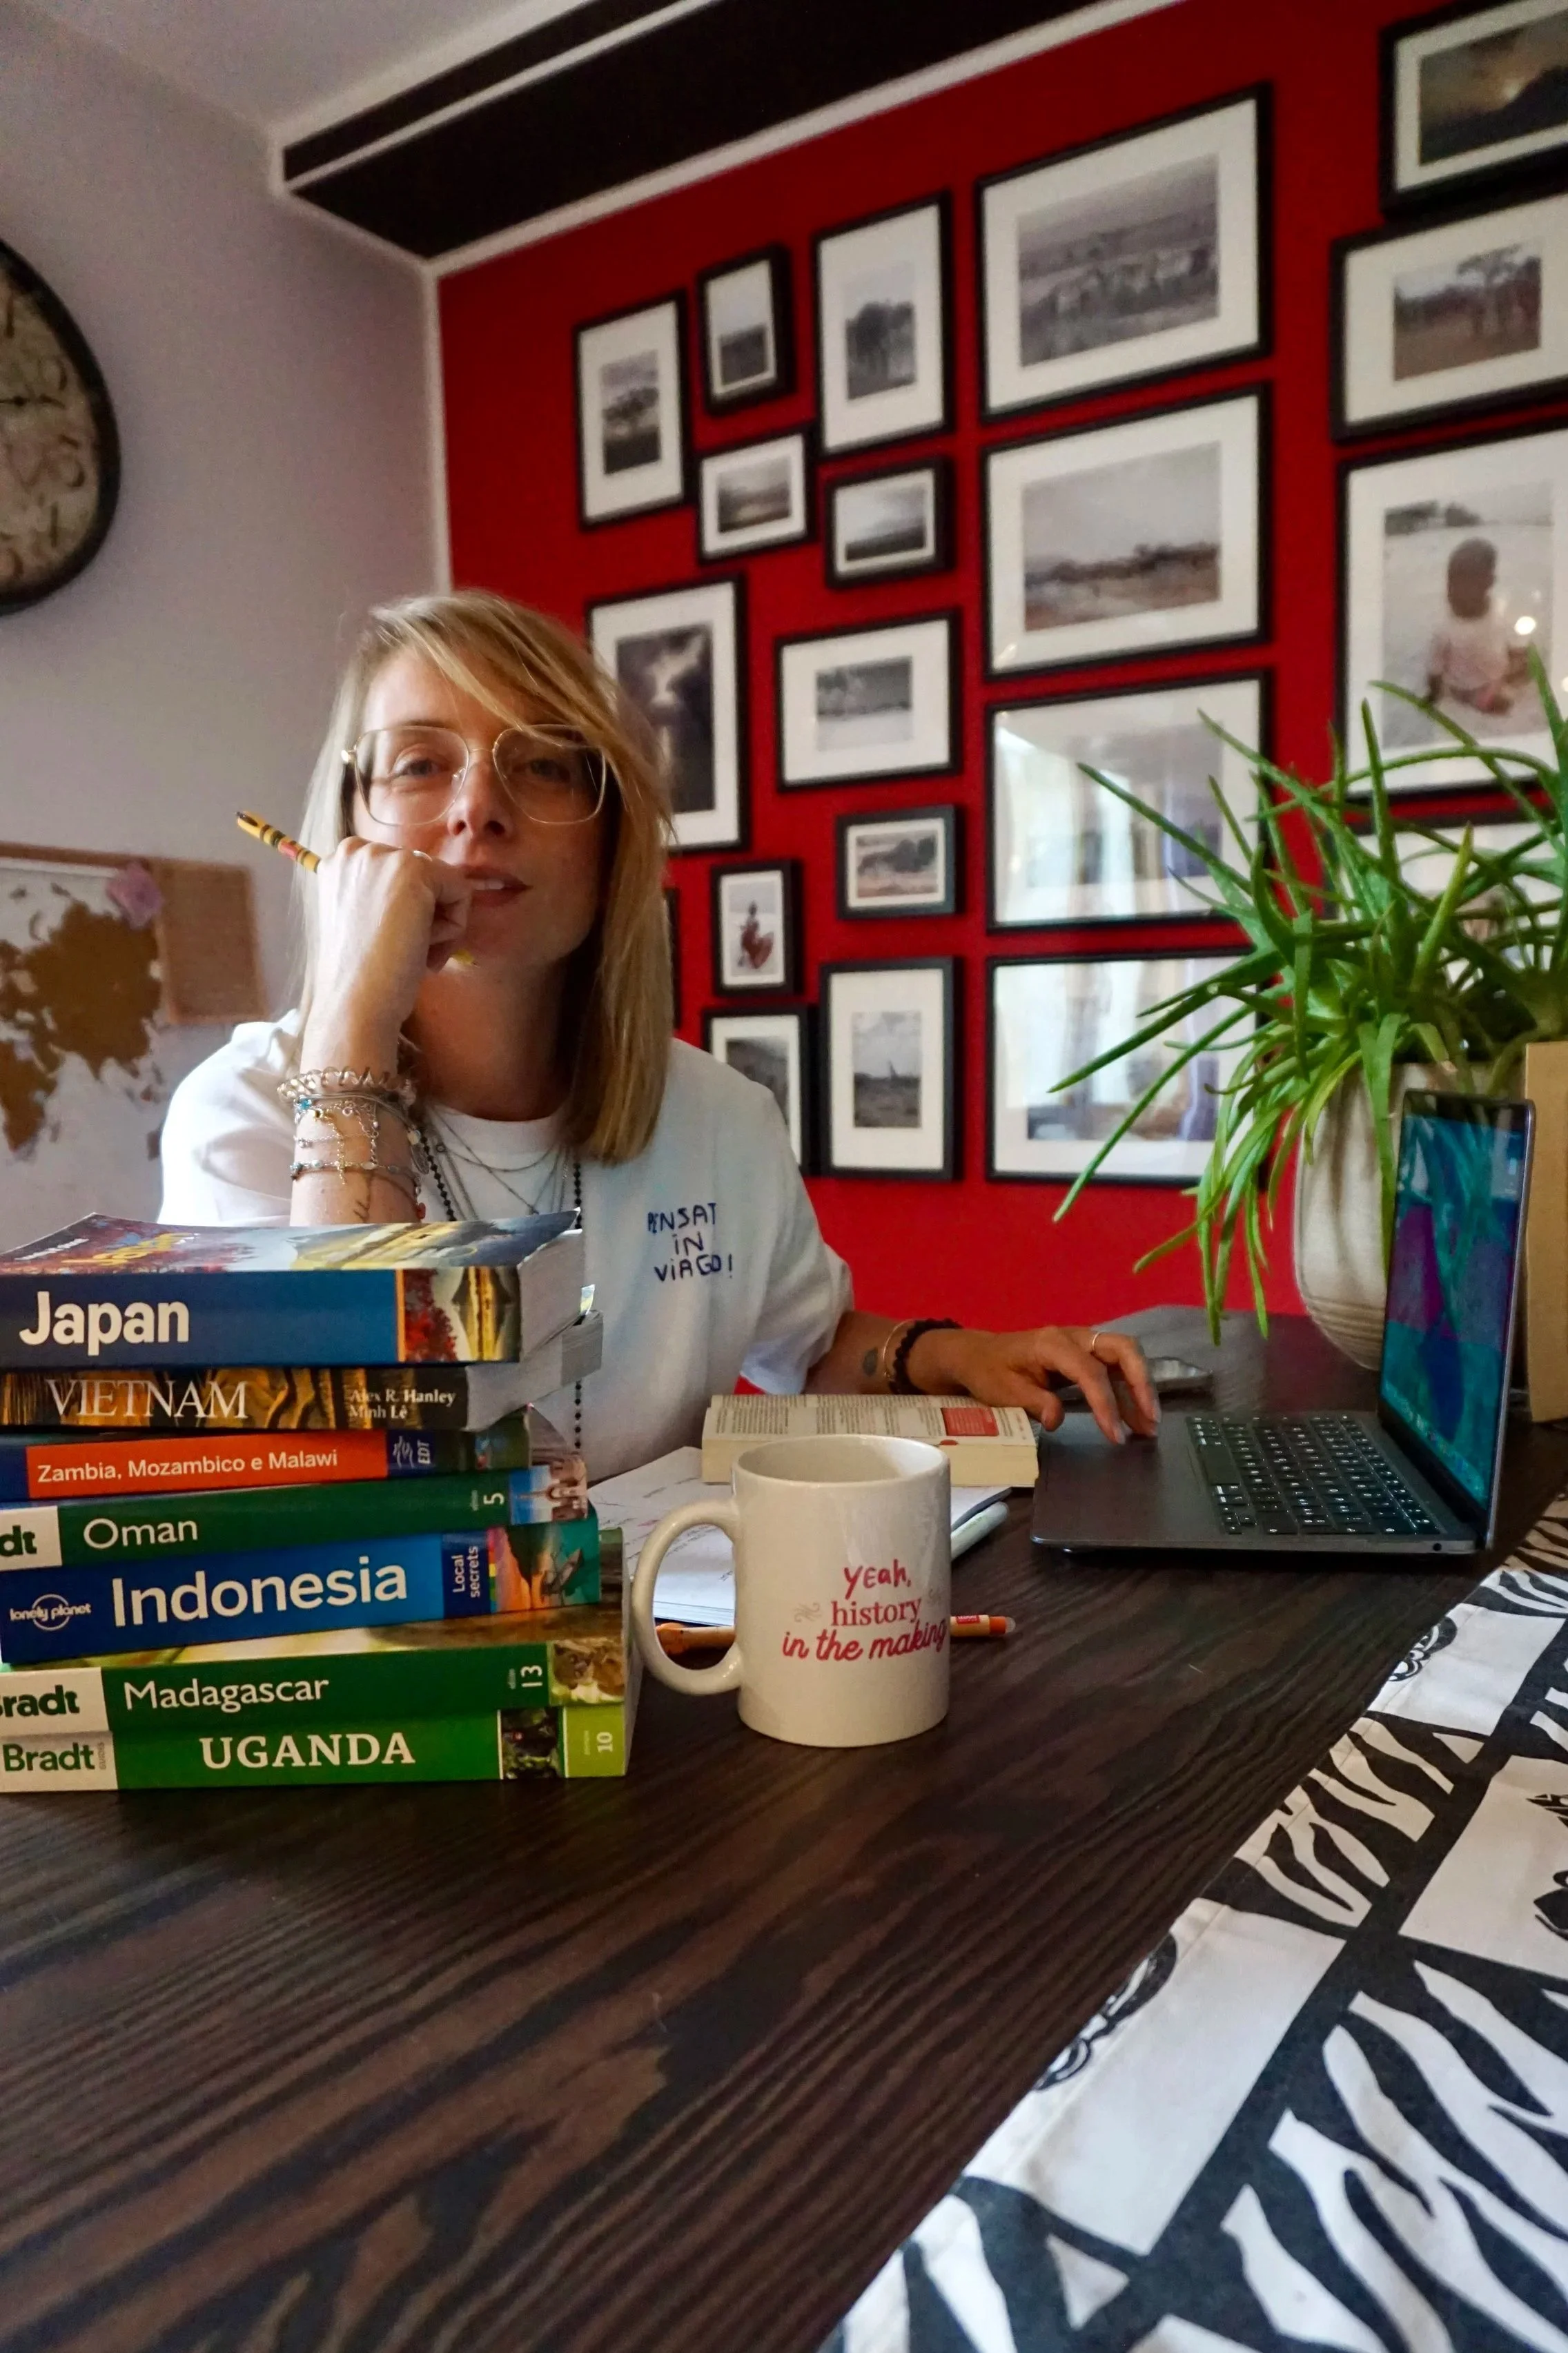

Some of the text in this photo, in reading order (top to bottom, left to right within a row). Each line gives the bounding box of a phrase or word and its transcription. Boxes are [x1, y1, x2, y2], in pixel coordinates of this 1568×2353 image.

[19, 1291, 190, 1356] Japan
[45, 1379, 249, 1419] VIETNAM
[348, 1405, 386, 1419] Minh
[386, 1388, 400, 1403] R.
[404, 1388, 456, 1407] Hanley
[37, 1449, 338, 1483] Zambia, Mozambico e Malawi
[417, 1440, 431, 1465] EDT
[484, 1492, 506, 1505] 5
[84, 1518, 198, 1550] Oman
[451, 1554, 466, 1593] Local
[467, 1545, 481, 1599] secrets
[112, 1555, 407, 1628] Indonesia
[10, 1602, 92, 1621] lonely planet
[830, 1597, 922, 1627] history
[782, 1617, 947, 1661] in the making
[520, 1664, 543, 1688] 13
[0, 1684, 80, 1717] radt
[124, 1678, 330, 1713] Madagascar
[2, 1741, 95, 1772] Bradt
[199, 1732, 416, 1770] UGANDA
[596, 1731, 614, 1754] 10
